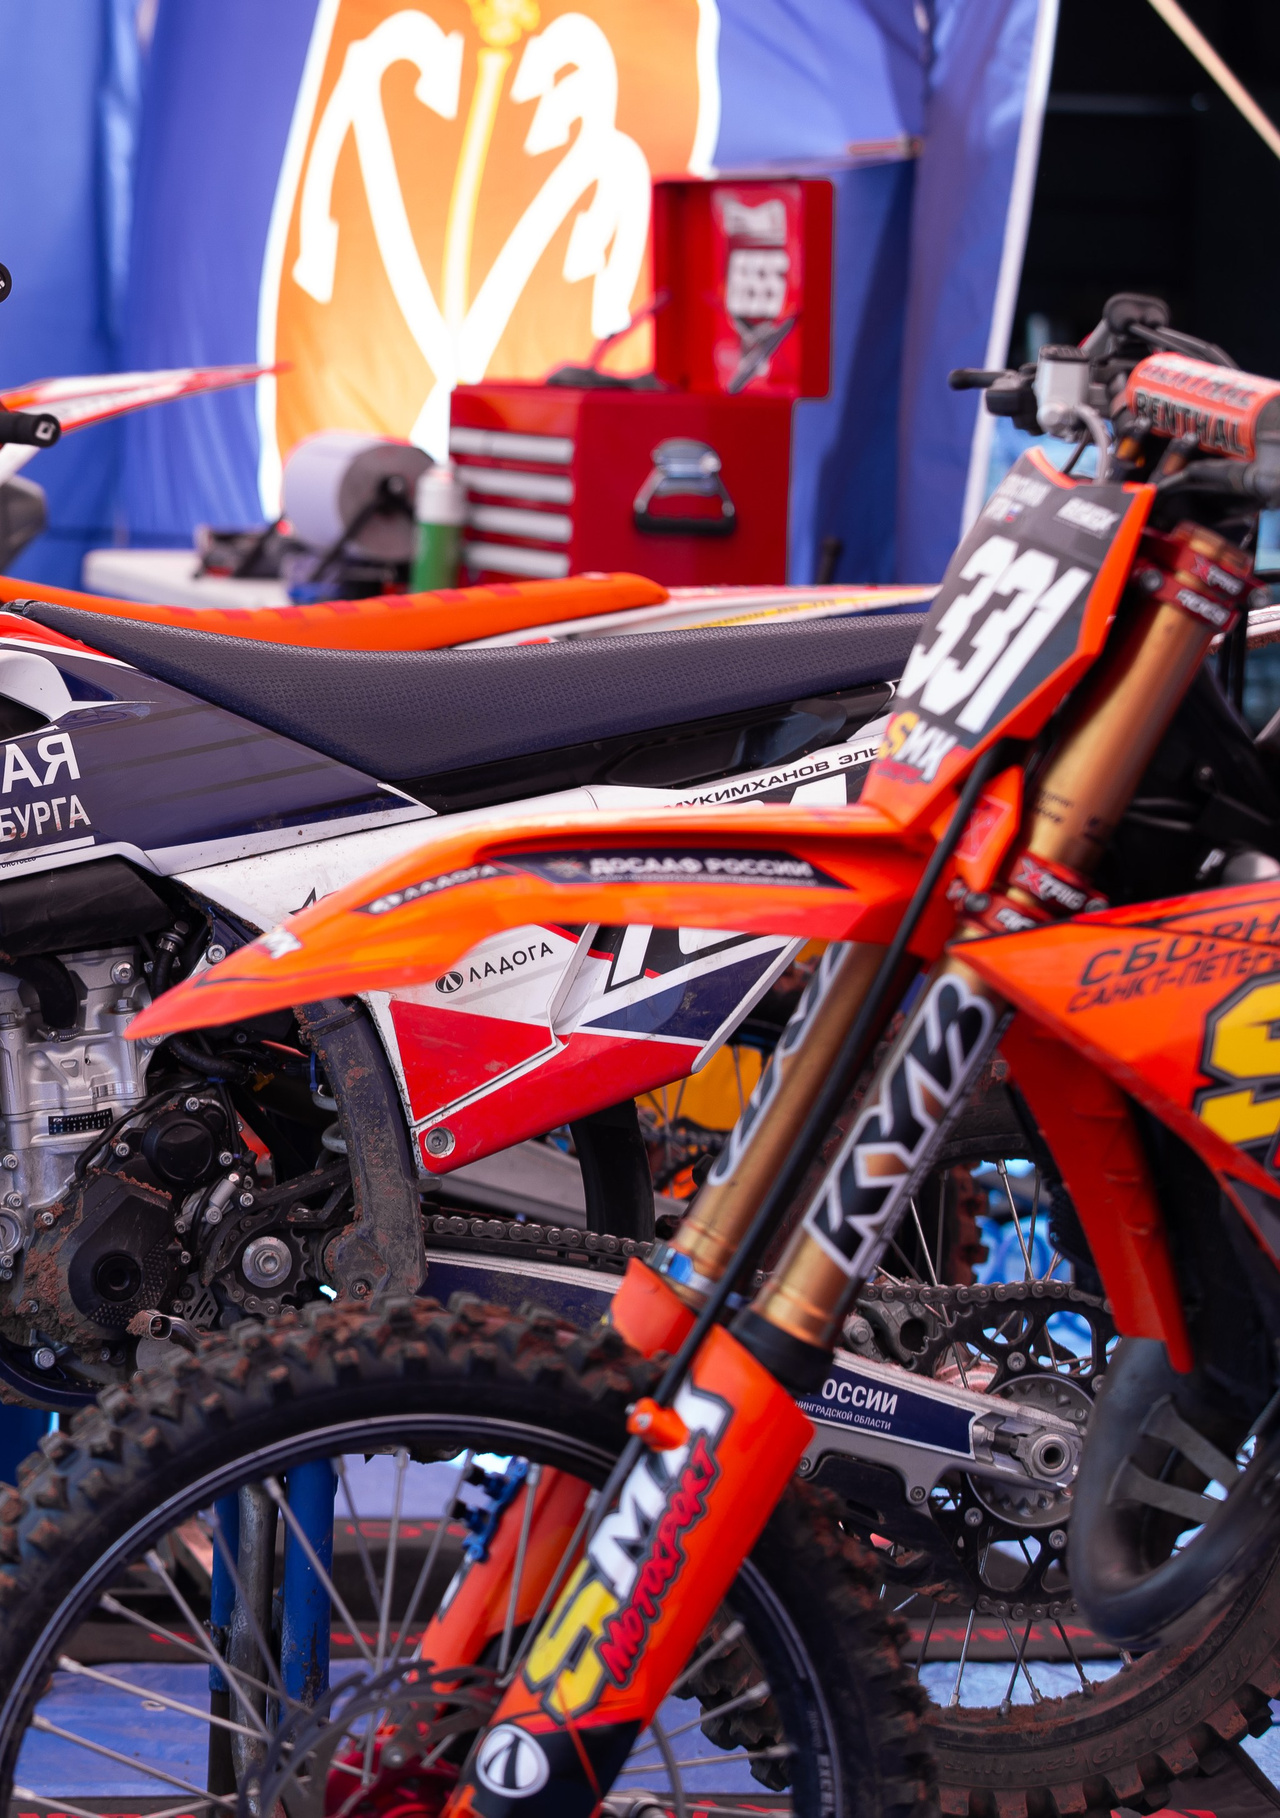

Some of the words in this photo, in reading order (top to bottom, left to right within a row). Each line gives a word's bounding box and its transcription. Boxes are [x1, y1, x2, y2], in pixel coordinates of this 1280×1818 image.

[1132, 388, 1249, 455] RENTHAL
[897, 534, 1093, 734] 331
[838, 746, 882, 766] ЭЛЬ
[589, 856, 704, 878] ДОСААФ
[706, 857, 814, 879] РОССИИ
[469, 941, 554, 983] ЛАДОГА
[1079, 914, 1280, 988] СБОРН
[1066, 944, 1280, 1013] САНКТ-ПЕТЕР
[802, 973, 996, 1278] KYB
[794, 1400, 853, 1422] НИНГРАДСКОЙ
[853, 1414, 892, 1431] ОБЛАСТИ
[821, 1378, 899, 1416] ОССИИ
